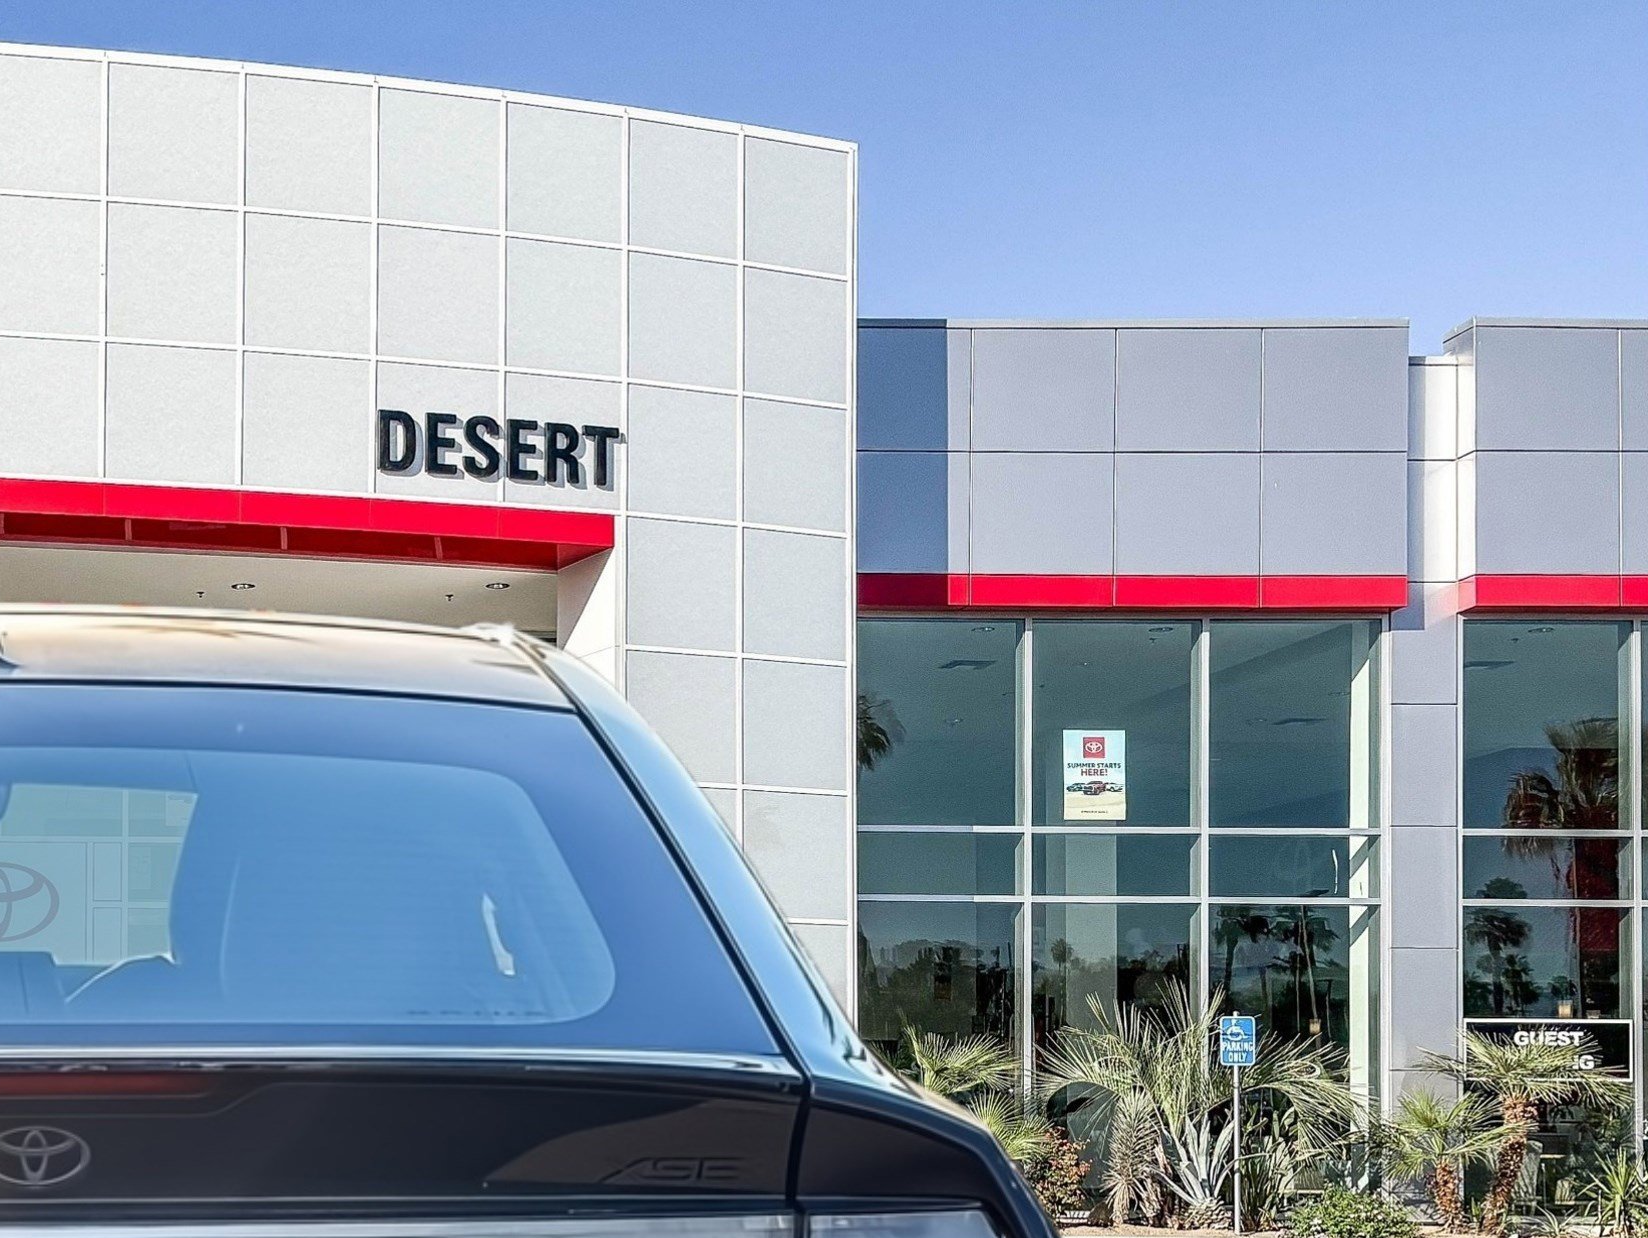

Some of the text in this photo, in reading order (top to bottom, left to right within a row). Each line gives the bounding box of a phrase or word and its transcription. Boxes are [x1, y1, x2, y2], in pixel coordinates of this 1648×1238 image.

[377, 409, 620, 486] DESERT
[1221, 1040, 1253, 1052] PARKING
[1228, 1052, 1248, 1063] ONLY
